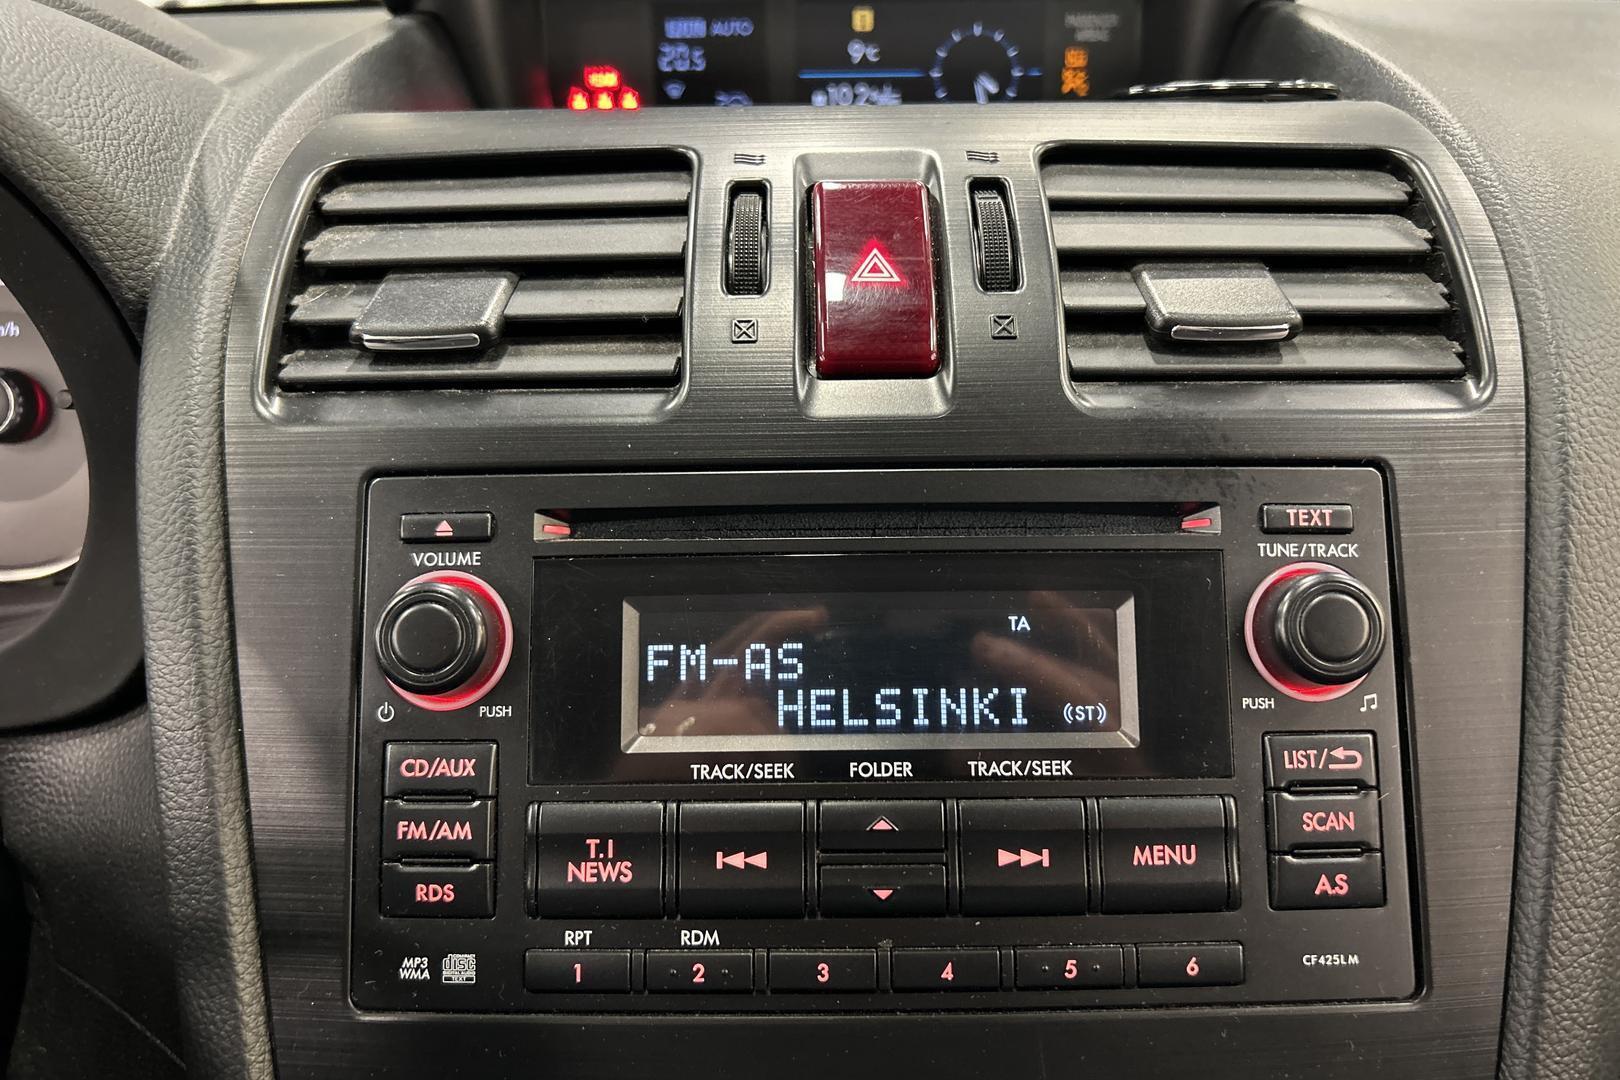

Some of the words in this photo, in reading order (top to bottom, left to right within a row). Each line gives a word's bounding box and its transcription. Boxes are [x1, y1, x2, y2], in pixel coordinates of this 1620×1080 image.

[1285, 508, 1333, 527] TEXT
[410, 551, 482, 567] VOLUME
[1256, 542, 1359, 558] TUNE/TRACK
[1007, 615, 1031, 632] TA
[645, 641, 804, 682] FM-AS
[479, 705, 512, 718] PUSH
[777, 687, 1028, 728] HELSINKI
[1242, 697, 1275, 710] PUSH
[399, 756, 476, 779] CD/AUX
[690, 762, 795, 780] TRACK/SEEK
[849, 761, 914, 778] FOLDER
[967, 759, 1074, 777] TRACK/SEEK
[397, 819, 473, 841] FM/AM
[1302, 810, 1356, 833] SCAN
[1132, 844, 1197, 866] MENU
[567, 860, 633, 884] NEWS
[415, 883, 455, 903] RDS
[564, 930, 593, 946] RPT
[680, 929, 720, 946] RDM
[401, 957, 429, 969] MP3
[1064, 959, 1078, 979] 5
[1186, 956, 1200, 977] 6
[1302, 954, 1360, 966] CF425LM
[399, 968, 431, 980] WMA
[573, 963, 582, 983] 1
[692, 962, 705, 983] 2
[816, 962, 830, 983] 3
[940, 961, 954, 981] 4
